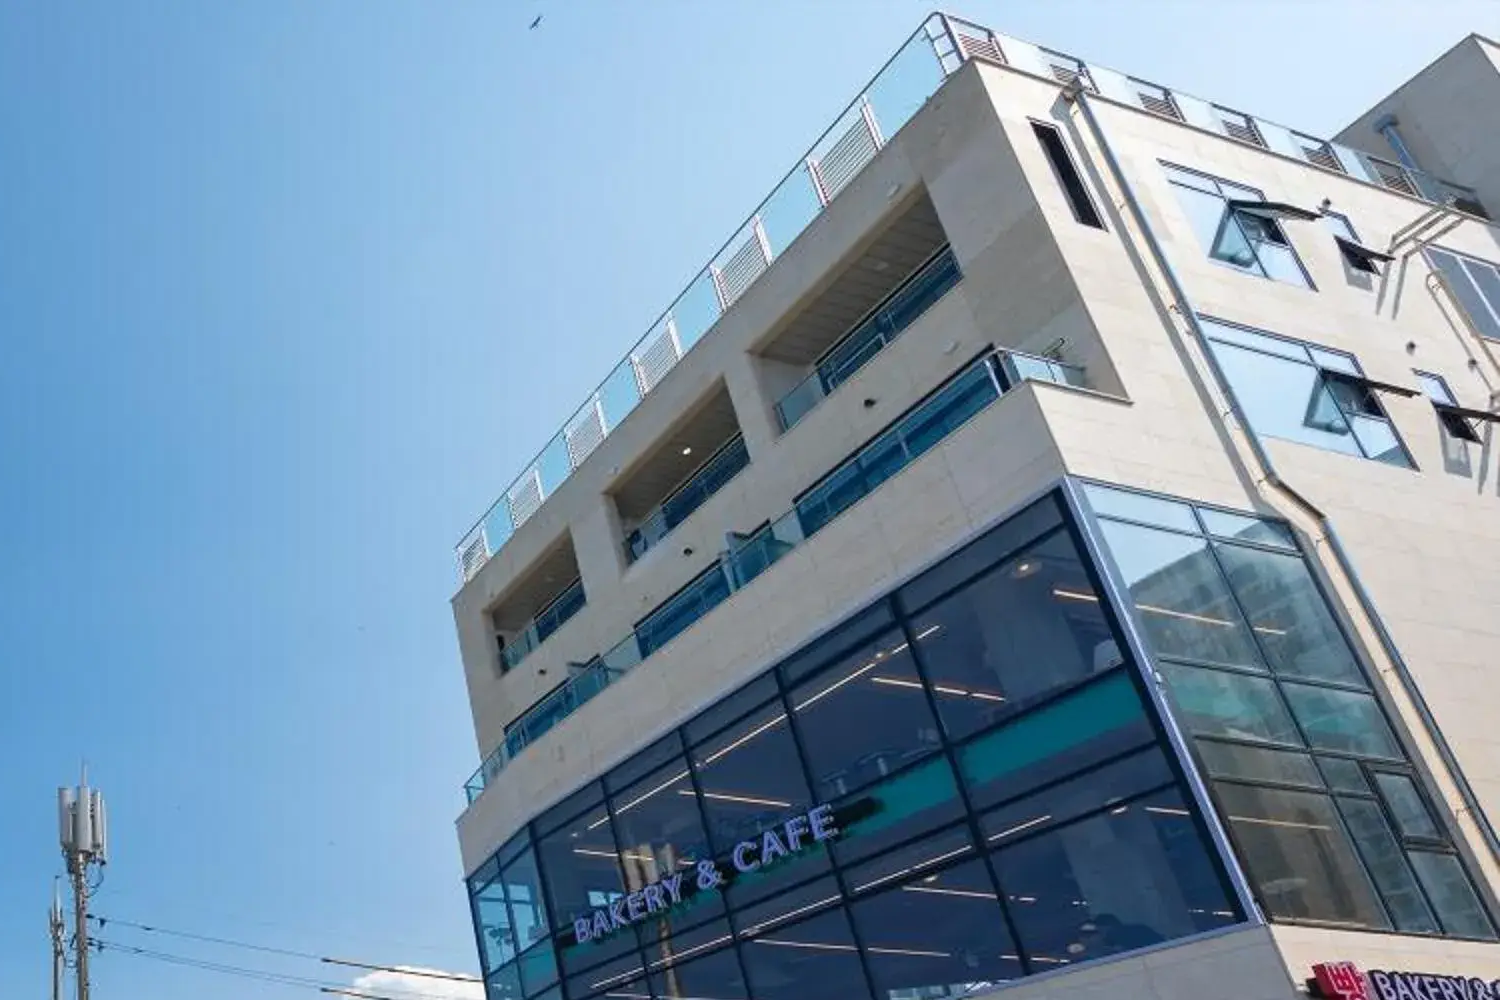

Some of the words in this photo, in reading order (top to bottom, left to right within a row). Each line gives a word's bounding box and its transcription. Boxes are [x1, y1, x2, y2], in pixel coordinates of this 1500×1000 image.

[573, 873, 684, 943] BAKERY
[696, 860, 723, 890] &
[733, 803, 839, 873] CAFE
